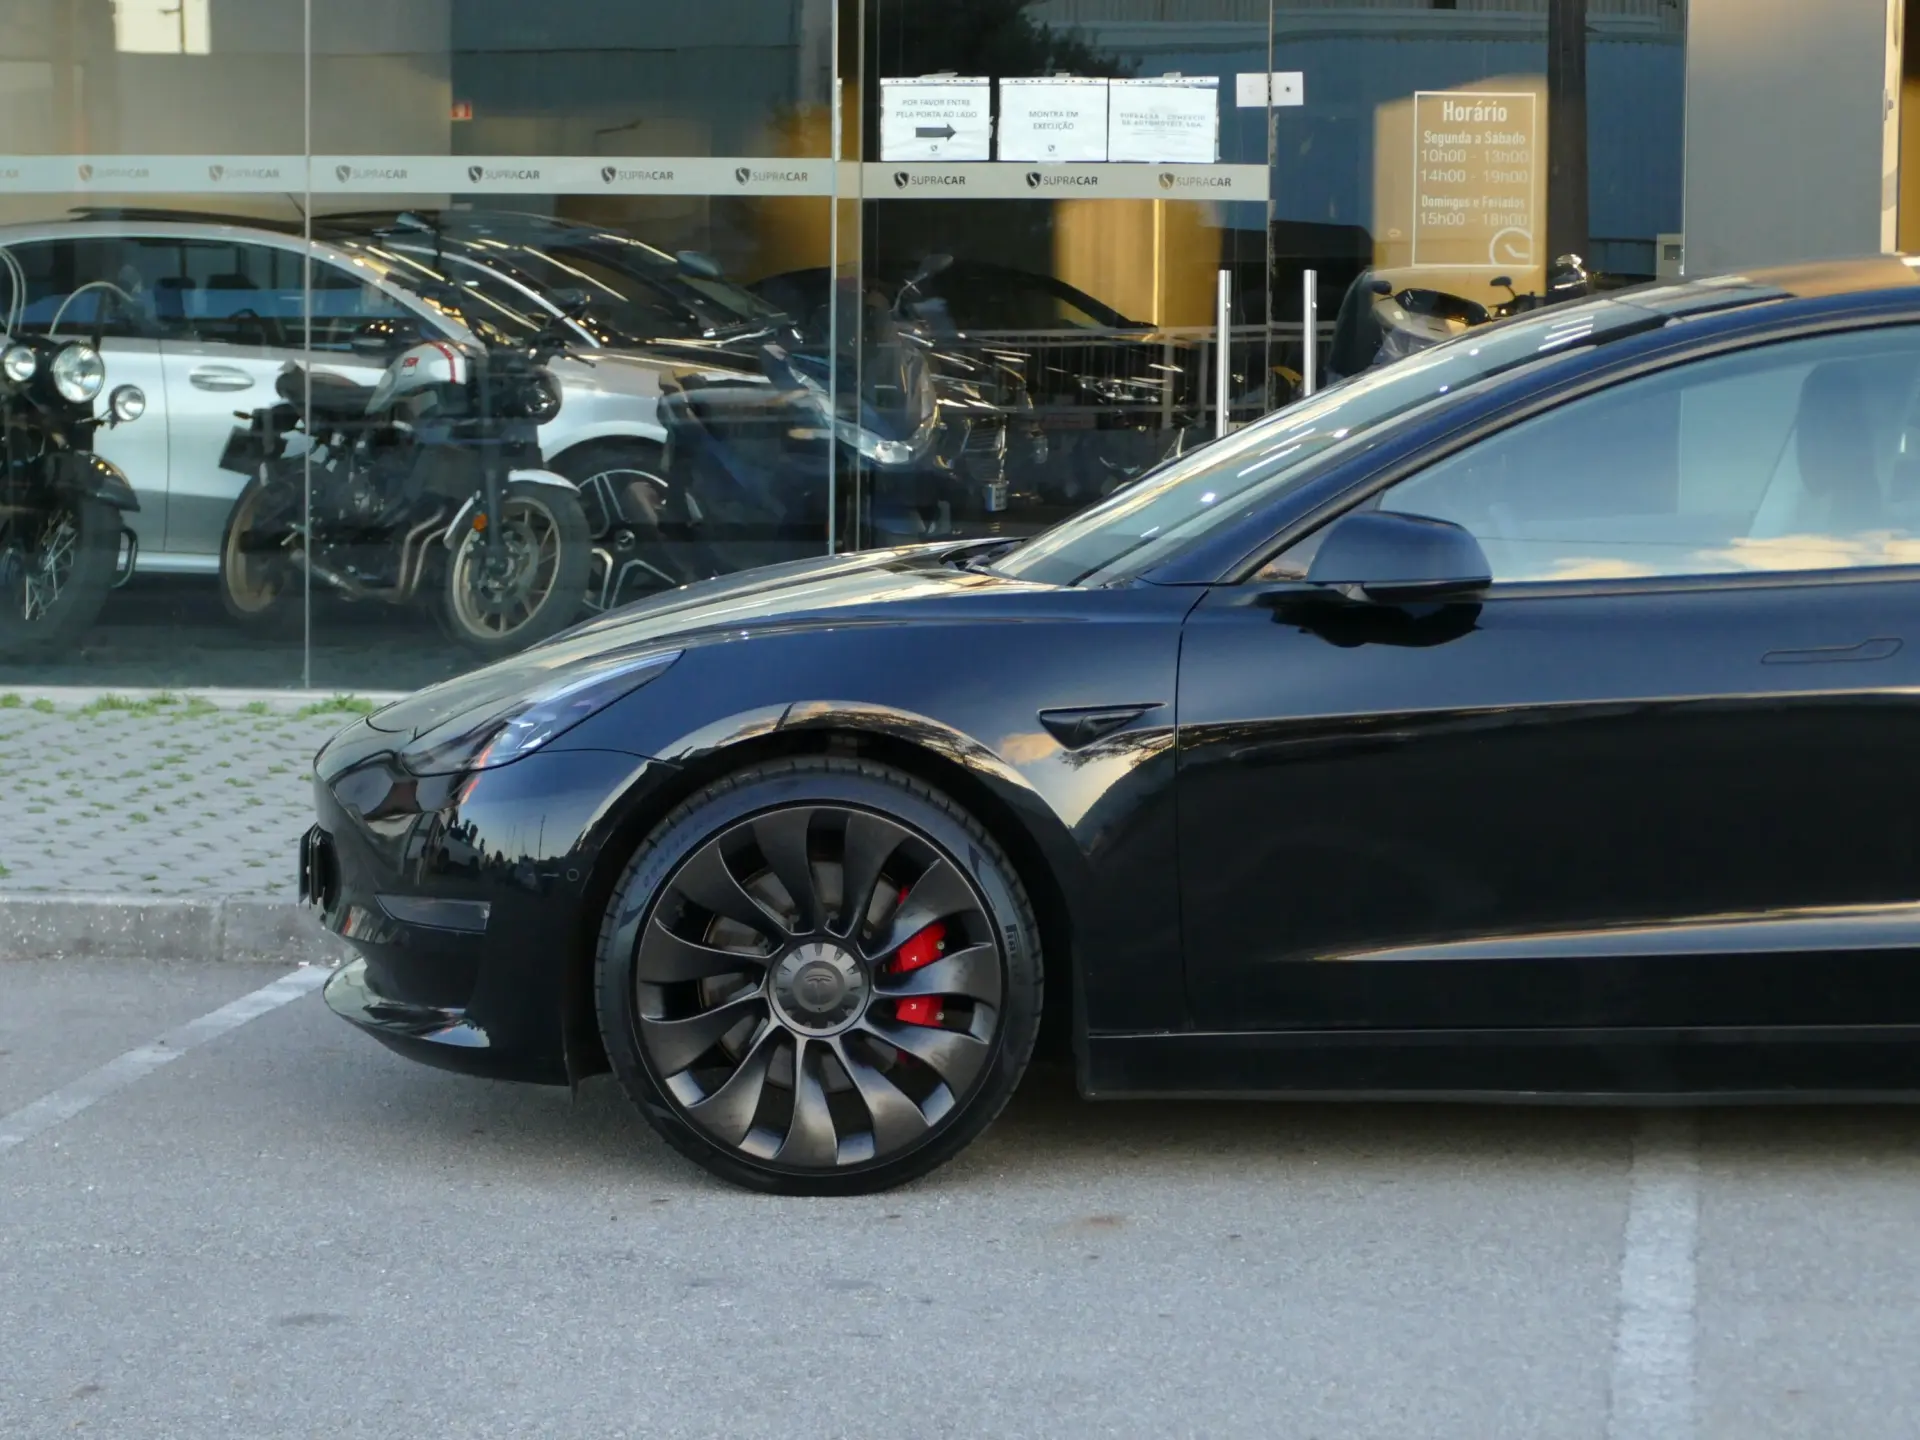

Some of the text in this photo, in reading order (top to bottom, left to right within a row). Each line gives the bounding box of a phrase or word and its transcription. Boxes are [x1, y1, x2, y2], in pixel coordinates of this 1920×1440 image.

[1443, 101, 1508, 122] Horário
[1033, 121, 1074, 131] EXECUÇÃO
[1424, 130, 1526, 147] Segunda a Sábado
[1421, 150, 1466, 163] 10h00
[1484, 150, 1529, 163] 13h00
[352, 168, 408, 180] SUPRACAR
[484, 170, 540, 181] SUPRACAR
[618, 170, 674, 181] SUPRACAR
[752, 171, 808, 182] SUPRACAR
[1420, 169, 1466, 182] 14h00
[1484, 170, 1528, 183] 19h00
[911, 175, 966, 187] SUPRACAR
[1043, 175, 1099, 187] SUPRACAR
[1176, 176, 1232, 188] SUPRACAR
[1422, 195, 1525, 210] Domingos e Feriados
[1420, 212, 1465, 225] 15h00
[1483, 213, 1527, 226] 18h00
